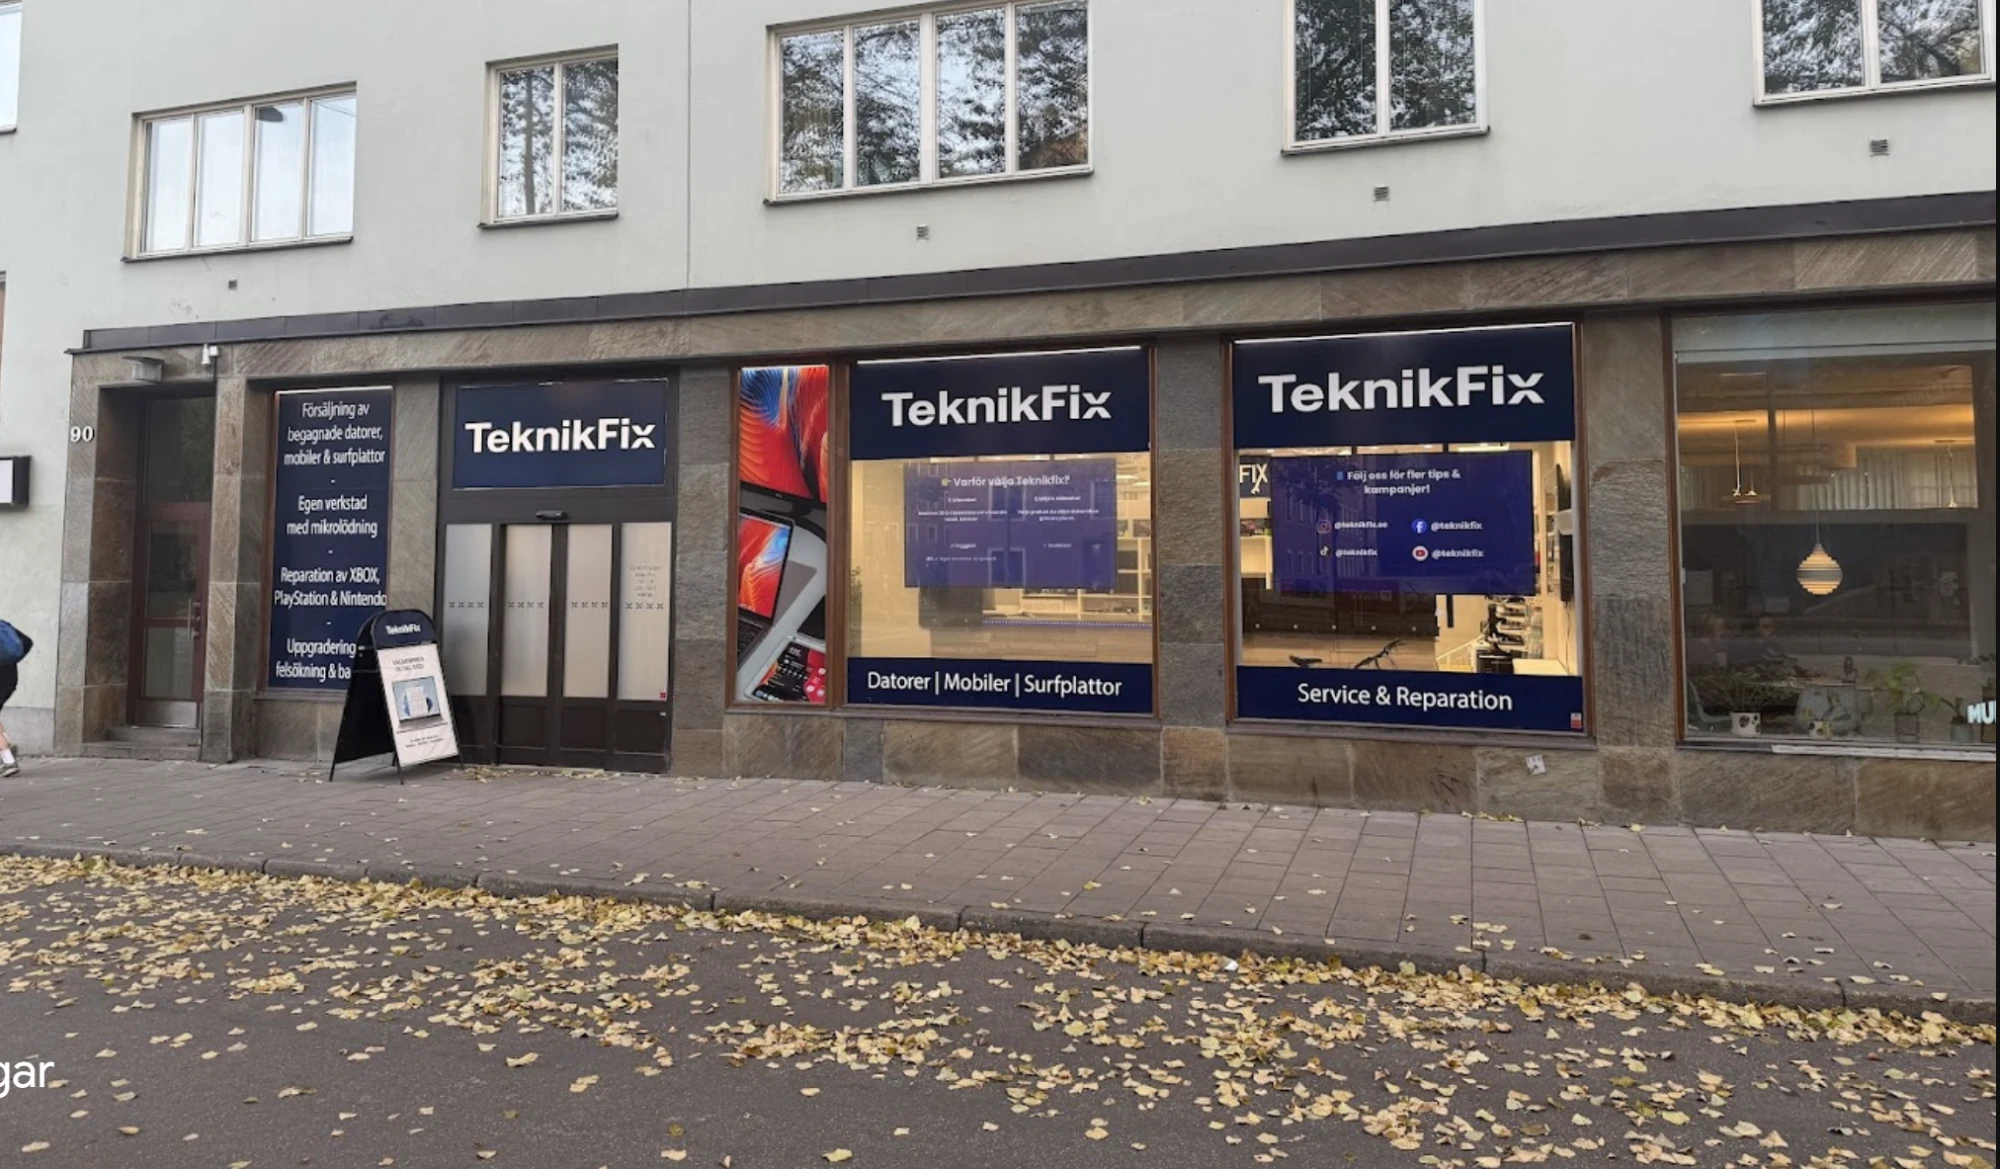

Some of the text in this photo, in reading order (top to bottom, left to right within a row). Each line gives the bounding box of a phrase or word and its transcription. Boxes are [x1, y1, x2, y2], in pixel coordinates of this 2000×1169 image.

[1258, 364, 1545, 414] TeknikFix
[301, 400, 371, 421] Försäljning av
[881, 384, 1113, 427] TeknikFix
[70, 425, 93, 443] 90
[287, 423, 384, 446] begagnade datorer,
[464, 417, 657, 453] TeknikFix
[283, 447, 386, 467] mobiler & surfplattor
[953, 474, 1071, 488] Varför välja Teknikfix?
[1347, 468, 1461, 483] Följ oss för fler tips &
[1364, 483, 1431, 496] kampanjer!
[298, 494, 368, 515] Egen verkstad
[286, 517, 378, 538] med mikrolödning
[1431, 521, 1483, 532] @teknikfix
[1432, 549, 1484, 561] @teknikfix
[280, 566, 381, 586] Reparation av XBOX,
[274, 589, 388, 609] PlayStation & Nintendo
[287, 638, 357, 659] Uppgradering
[275, 661, 327, 683] felsökning
[327, 662, 337, 680] &
[867, 671, 931, 690] Datorer
[944, 672, 1011, 693] Mobiler
[1024, 674, 1122, 698] Surfplattor
[1297, 683, 1513, 711] Service & Reparation
[1967, 700, 1996, 725] MU
